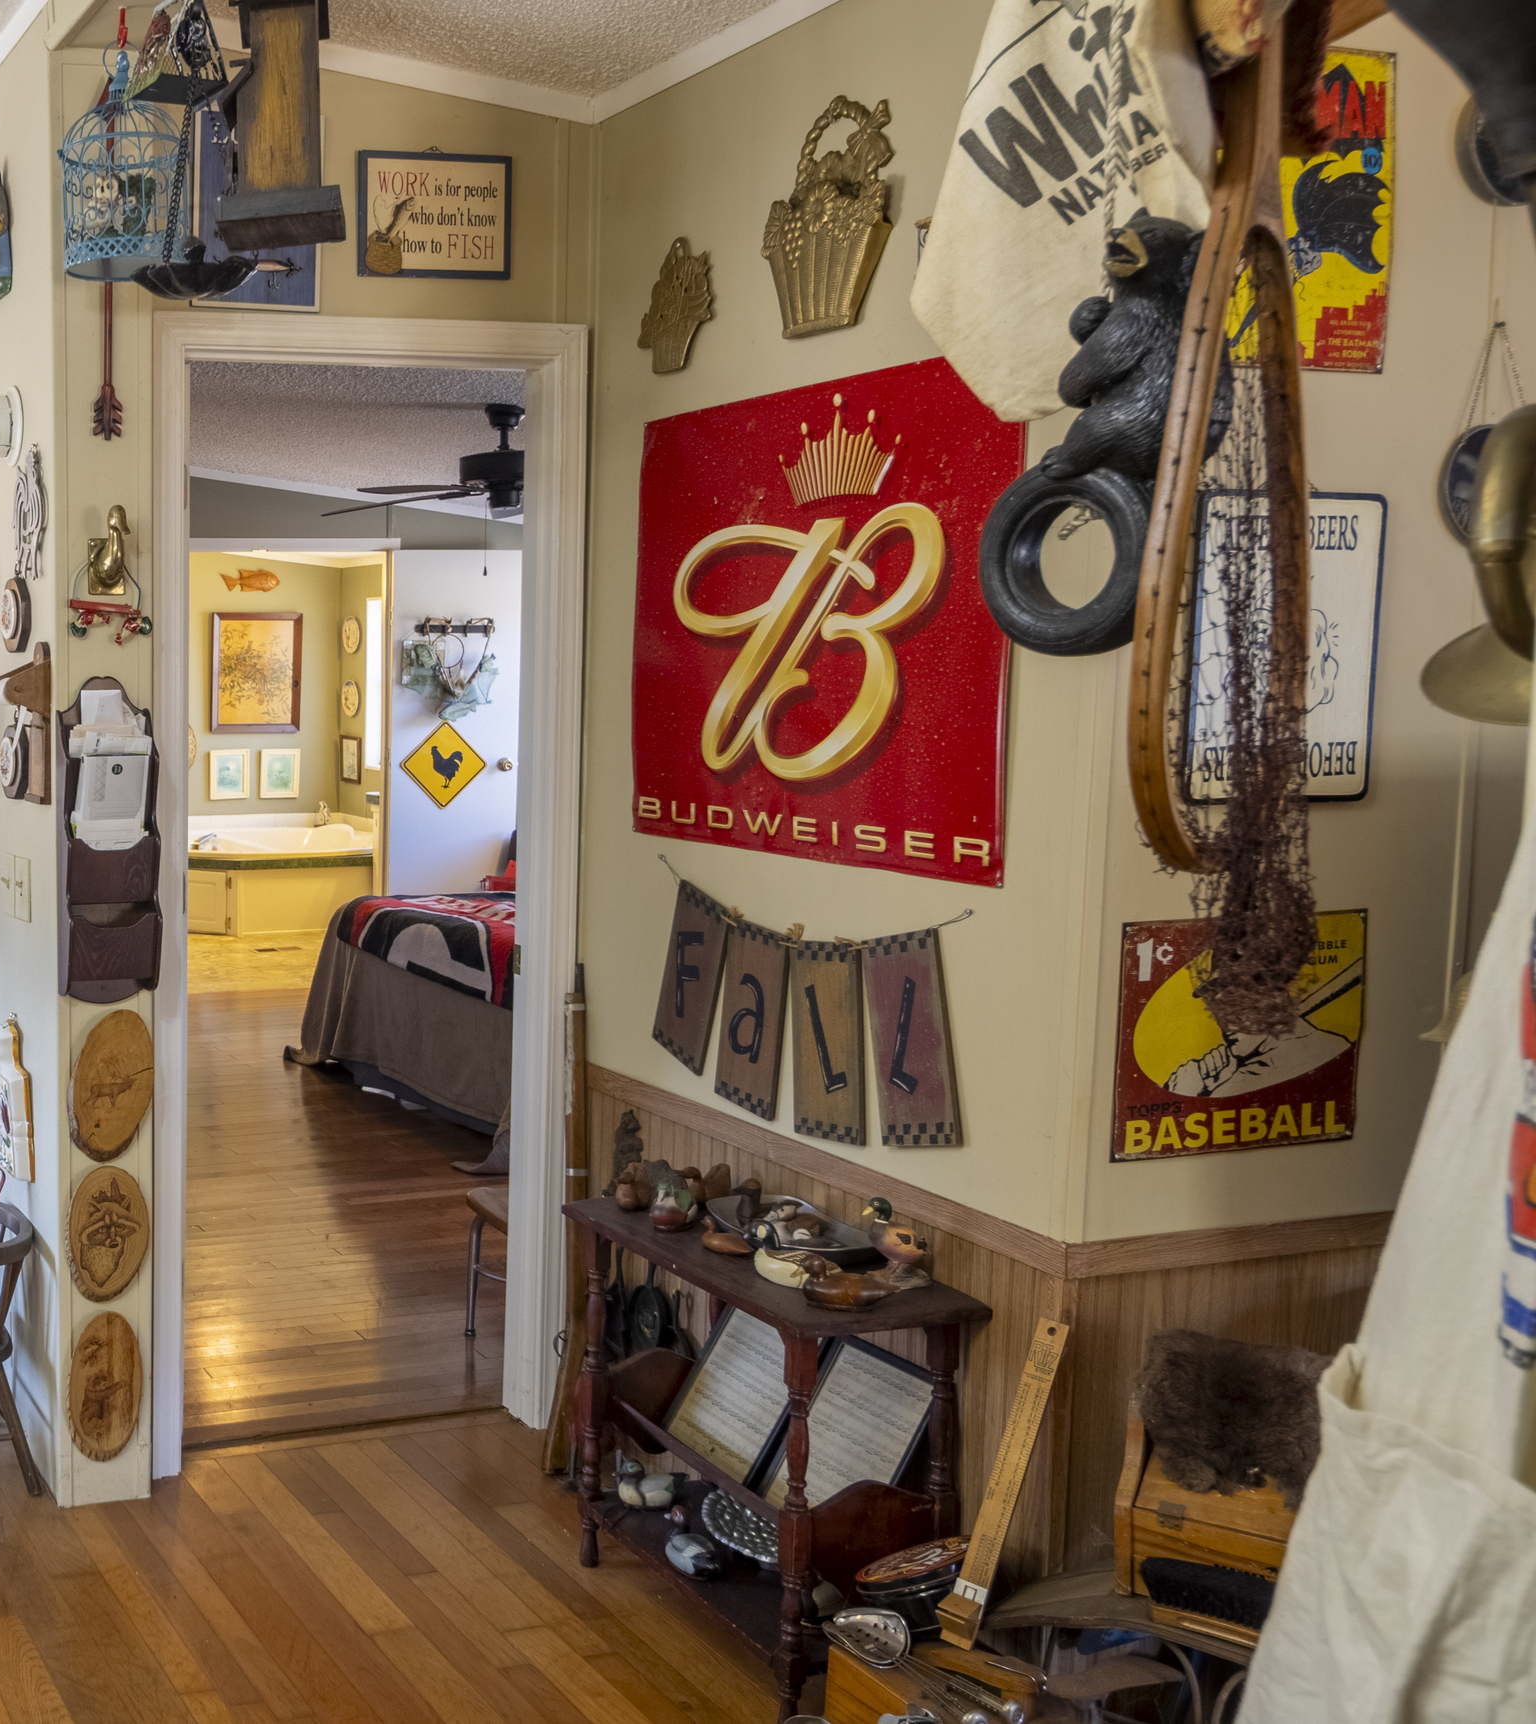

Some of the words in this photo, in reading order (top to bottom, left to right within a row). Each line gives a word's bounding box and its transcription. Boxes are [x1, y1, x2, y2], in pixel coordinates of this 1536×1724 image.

[1316, 81, 1387, 140] MAN
[378, 171, 430, 196] WORK
[434, 178, 443, 196] is
[446, 178, 462, 197] for
[464, 180, 498, 202] people
[409, 206, 434, 225] who
[437, 206, 465, 226] don't
[467, 207, 498, 228] know
[402, 230, 428, 253] how
[431, 237, 442, 255] to
[447, 233, 495, 260] FISH
[1328, 337, 1341, 347] THE
[1343, 338, 1379, 348] BATMAN
[1342, 349, 1367, 358] ROBIN
[637, 795, 992, 868] BUDWEISER
[1317, 939, 1348, 951] BBLE
[1127, 1100, 1183, 1119] TOPPS
[1124, 1101, 1346, 1155] BASEBALL
